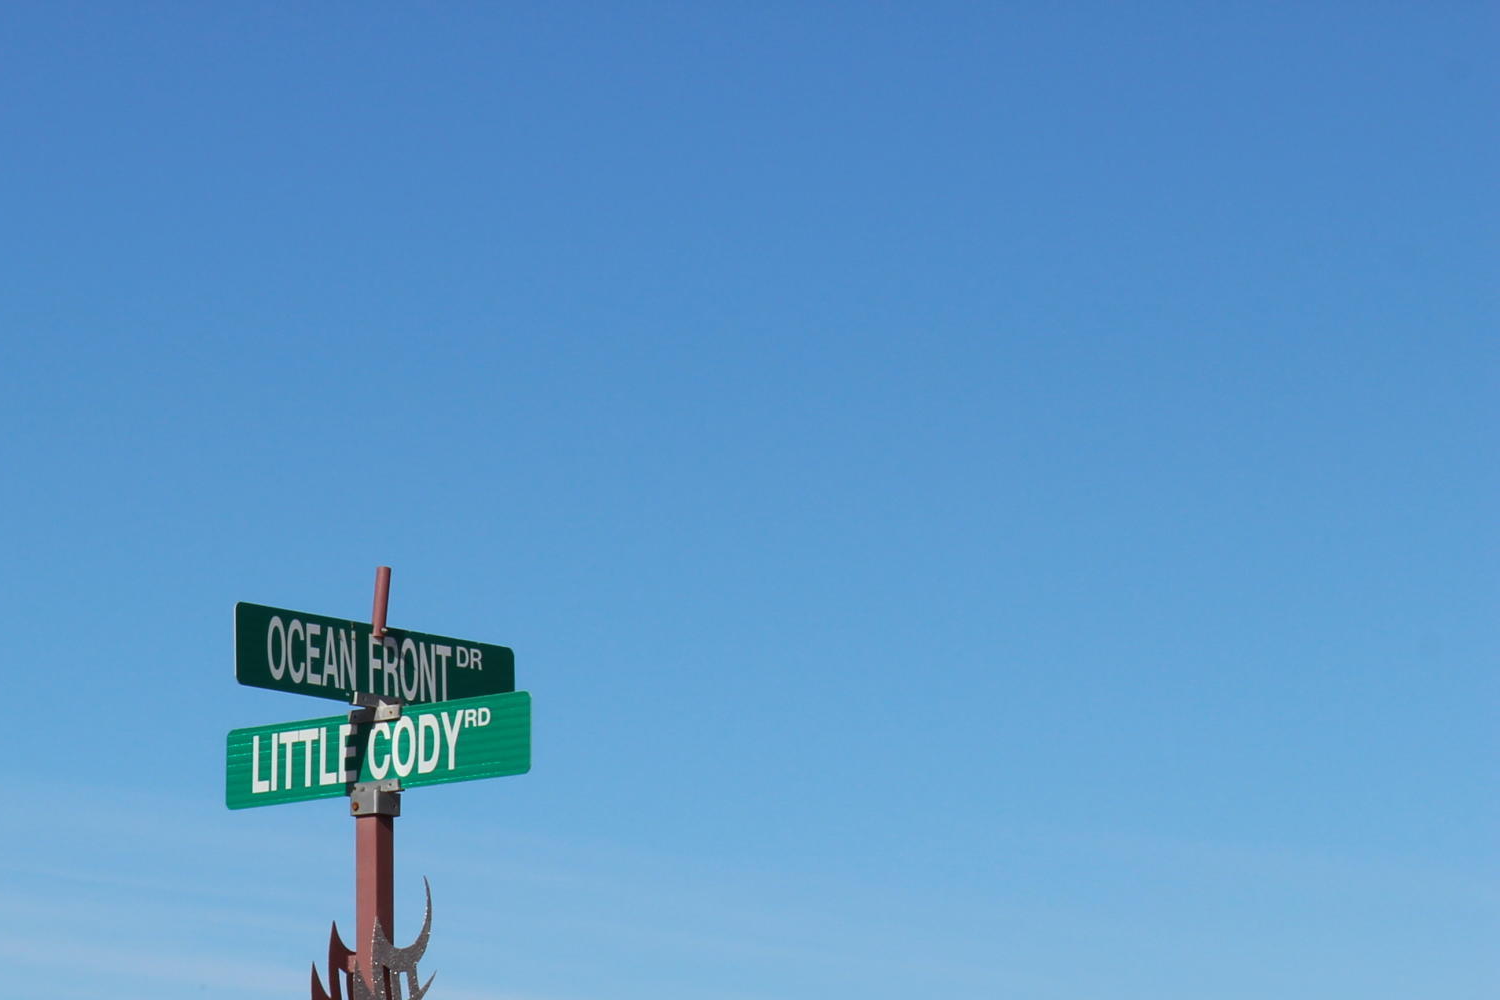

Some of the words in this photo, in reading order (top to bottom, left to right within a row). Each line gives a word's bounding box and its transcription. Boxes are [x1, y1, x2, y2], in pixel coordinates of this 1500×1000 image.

[267, 616, 356, 690] OCEAN
[368, 633, 451, 704] FRONT
[456, 646, 482, 671] DR
[252, 723, 357, 794] LITTLE
[367, 714, 464, 781] CODY
[464, 707, 491, 728] RD
